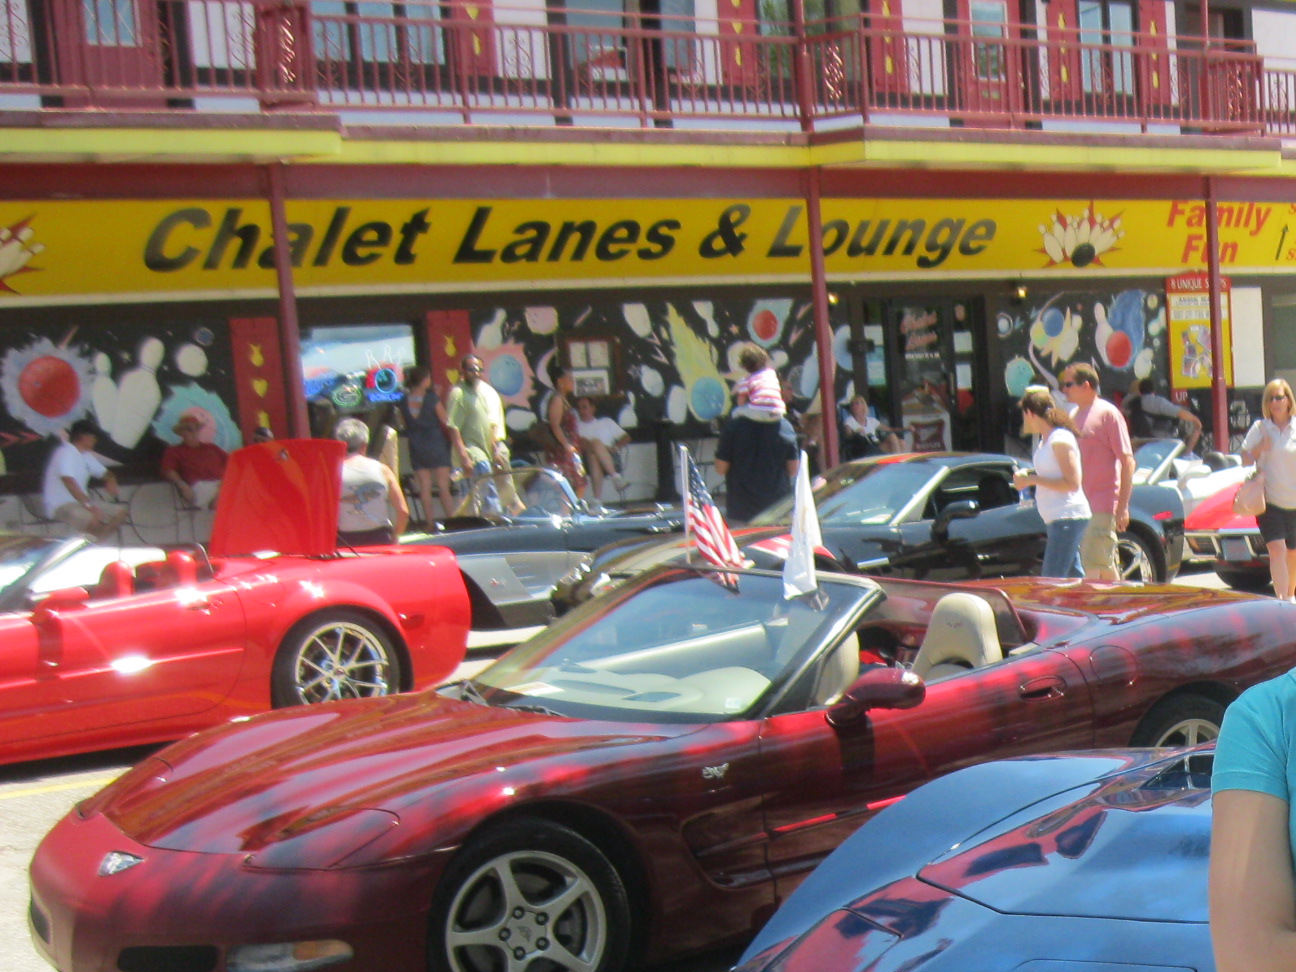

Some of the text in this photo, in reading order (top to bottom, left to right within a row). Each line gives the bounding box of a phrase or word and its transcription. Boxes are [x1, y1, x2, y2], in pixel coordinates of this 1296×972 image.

[143, 203, 998, 273] Chalet Lanes & Lounge
[1177, 278, 1202, 291] UNIQUE
